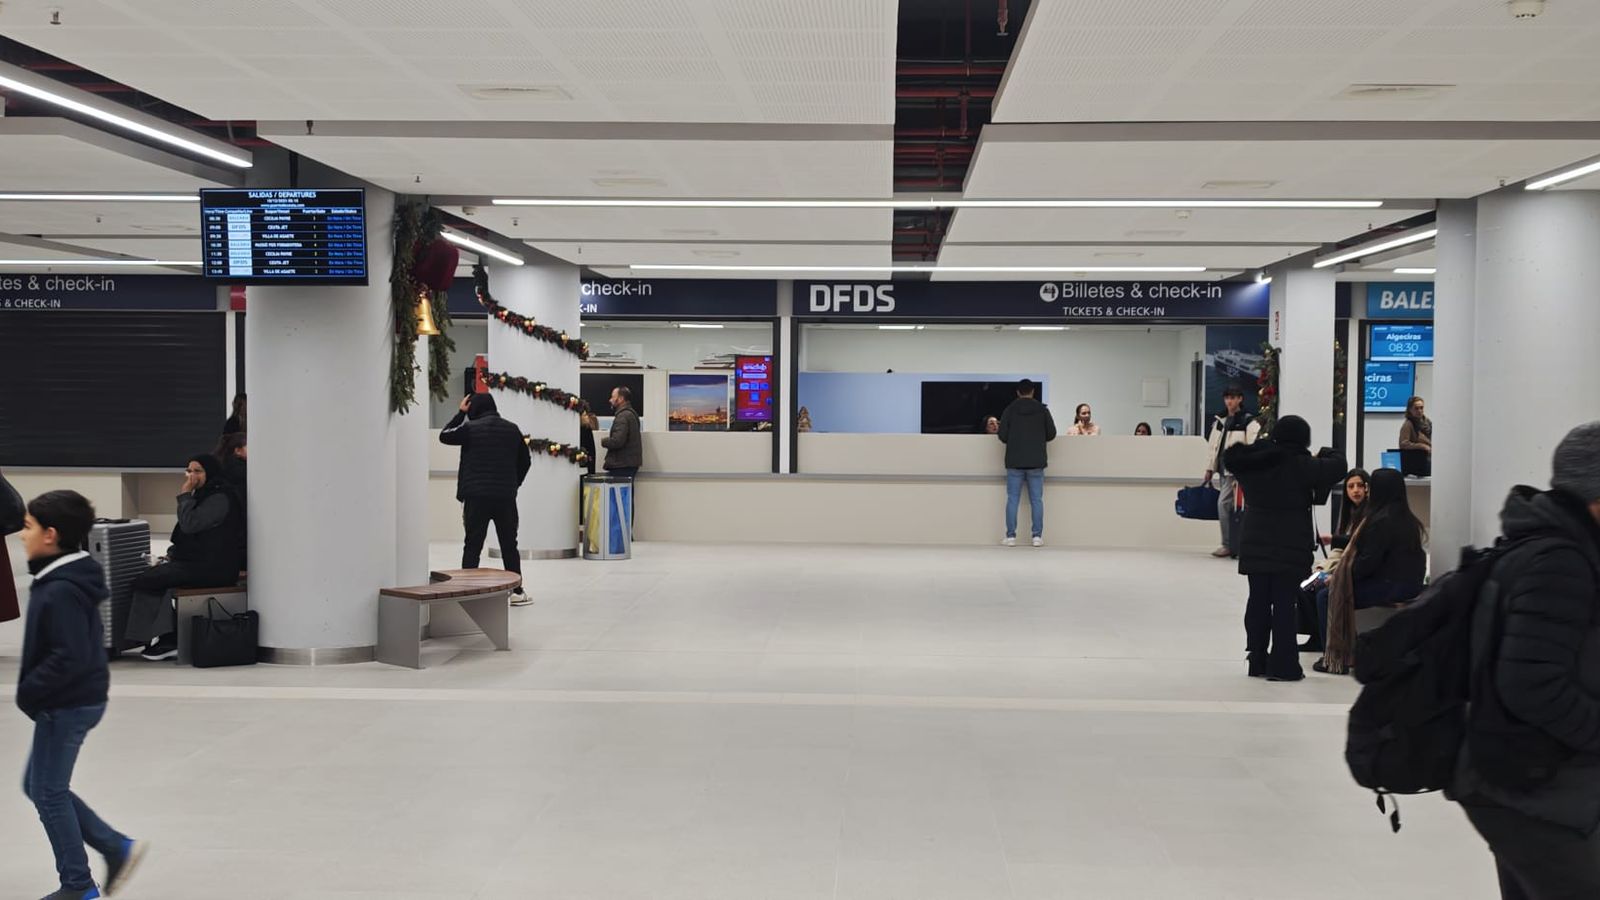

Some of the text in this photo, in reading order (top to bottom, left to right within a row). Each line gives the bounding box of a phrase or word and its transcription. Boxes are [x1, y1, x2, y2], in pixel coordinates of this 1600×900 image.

[28, 275, 39, 290] &
[45, 275, 115, 291] check-in
[581, 280, 652, 296] check-in
[1062, 282, 1125, 298] Billetes
[1130, 282, 1143, 298] &
[1149, 282, 1222, 298] check-in
[14, 299, 61, 308] CHECK-IN
[809, 284, 896, 313] DFDS
[1380, 291, 1434, 309] BALE
[1063, 306, 1165, 316] TICKETS & CHECK-IN
[1386, 333, 1422, 341] Algeciras
[1364, 373, 1392, 382] ciras
